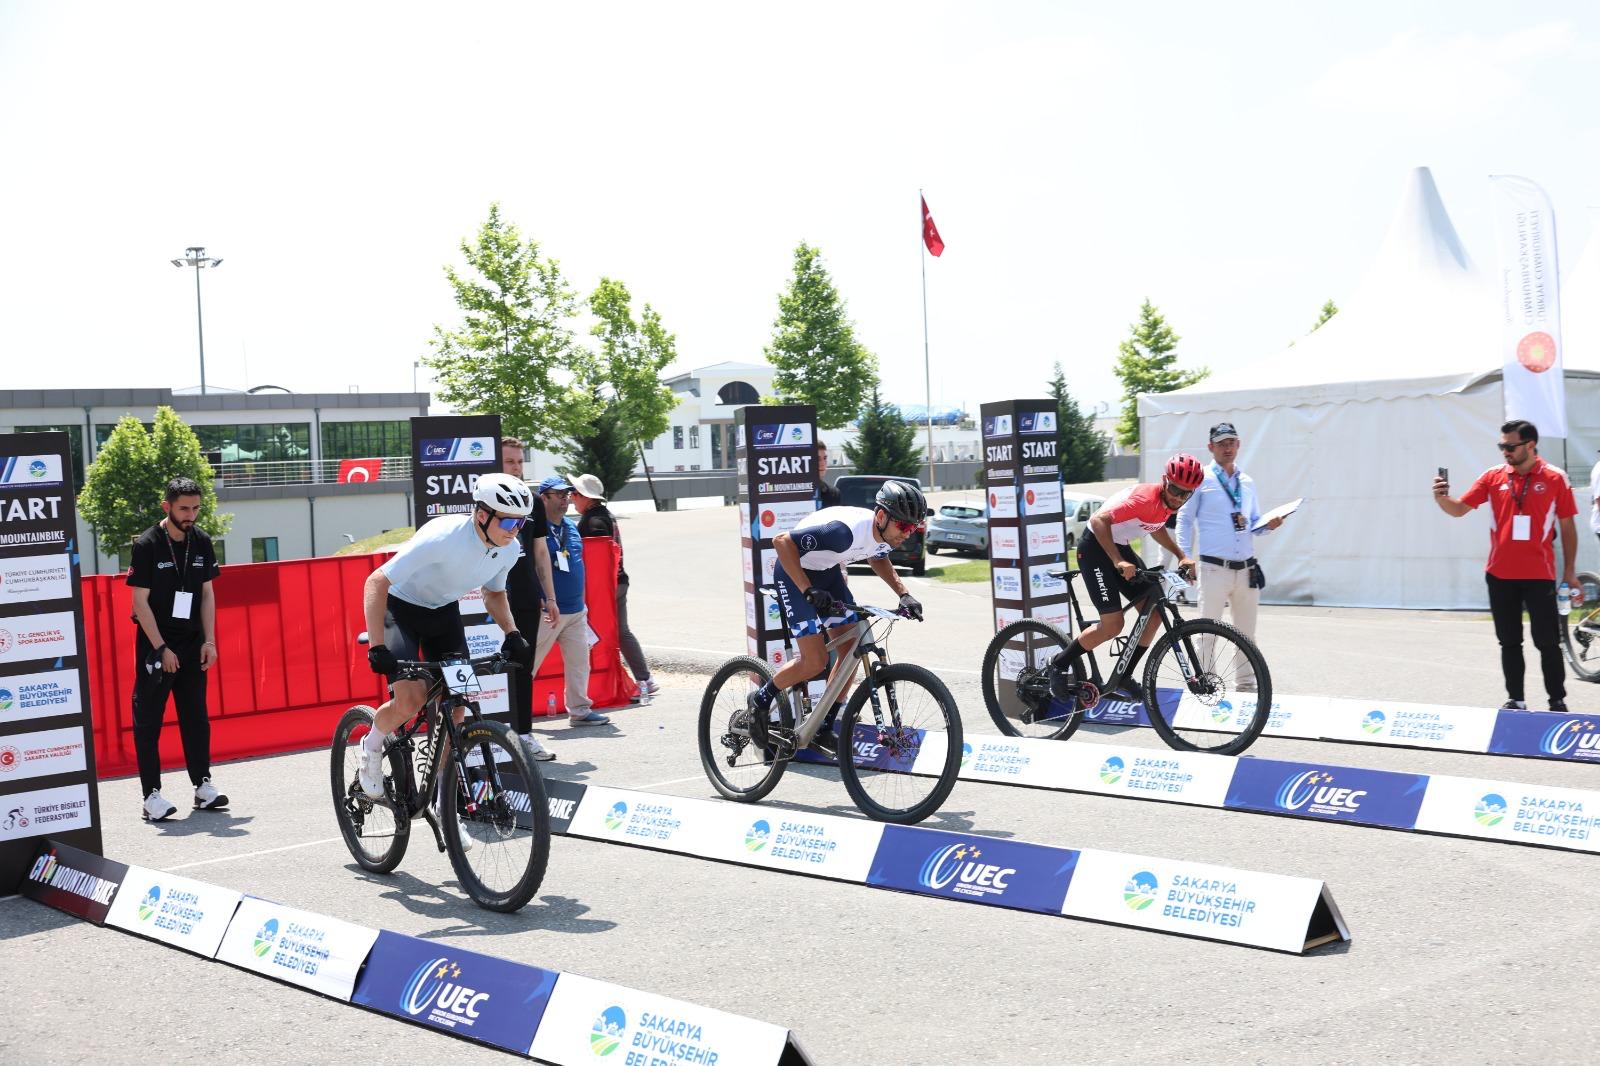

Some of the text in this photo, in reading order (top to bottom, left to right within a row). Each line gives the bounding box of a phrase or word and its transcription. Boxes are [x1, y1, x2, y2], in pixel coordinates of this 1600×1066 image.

[986, 445, 1013, 462] START
[1022, 441, 1057, 459] START
[758, 456, 812, 475] START
[426, 474, 480, 496] STAR
[0, 530, 65, 544] MOUNTAINBIKE
[1094, 567, 1109, 602] TÜRKİYE
[777, 580, 794, 618] HELLAS
[1116, 614, 1148, 675] ORBEA
[456, 668, 467, 682] 6
[19, 682, 59, 693] SAKARYA
[20, 688, 72, 700] BÜYÜKŞEHİR
[20, 696, 68, 708] BELEDİYESİ
[1107, 700, 1143, 715] UEC
[1395, 711, 1440, 721] SAKARYA
[981, 743, 1020, 754] SAKARYA
[1134, 757, 1180, 770] SAKARYA
[1130, 767, 1193, 783] BÜYÜKŞEHİR
[1127, 780, 1184, 793] BELEDİYESİ
[1314, 786, 1368, 808] UEC
[1520, 796, 1583, 812] SAKARYA
[34, 800, 86, 815] TÜRKİYE BİSİKLET
[635, 803, 673, 816] SAKARYA
[35, 811, 79, 824] FEDERASYONU
[1517, 808, 1600, 829] BÜYÜKŞEHİR
[780, 821, 825, 837] SAKARYA
[1512, 821, 1590, 841] BELEDİYESİ
[775, 833, 837, 853] BÜYÜKŞEHİR
[770, 846, 827, 864] BELEDİYESİ
[960, 861, 1017, 889] UEC
[50, 864, 119, 906] MOUNTAINBIKE
[1172, 875, 1237, 895] SAKARYA
[167, 888, 199, 906] SAKARYA
[1167, 889, 1256, 914] BÜYÜKŞEHİR
[1162, 905, 1243, 928] BELEDİYESİ
[286, 922, 326, 942] SAKARYA
[437, 982, 490, 1018] UEC
[639, 1012, 702, 1042] SAKARYA
[632, 1031, 719, 1066] BÜYÜKŞEHİR
